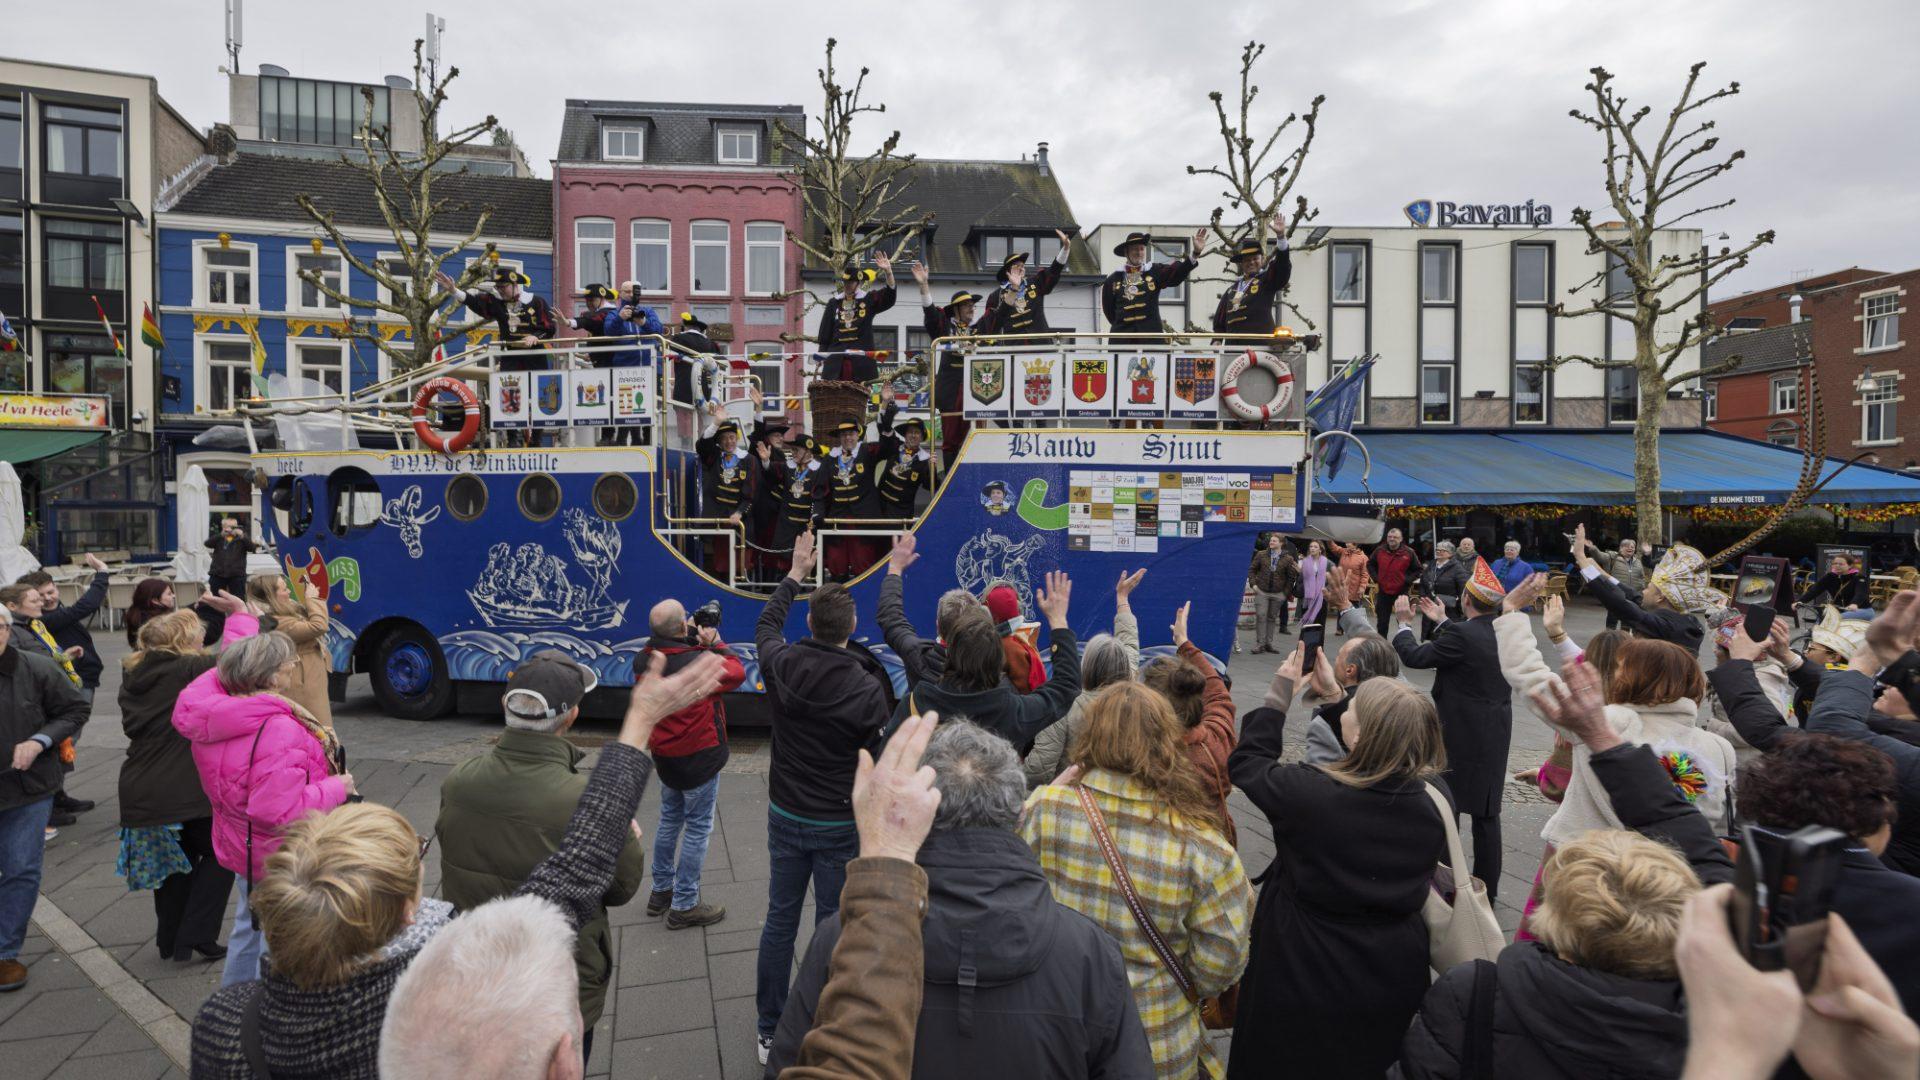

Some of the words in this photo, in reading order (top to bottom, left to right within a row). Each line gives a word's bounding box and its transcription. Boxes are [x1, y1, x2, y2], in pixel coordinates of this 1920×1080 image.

[1436, 198, 1552, 227] Bavaria
[11, 406, 26, 415] va
[1008, 431, 1096, 459] Blauw
[1142, 432, 1222, 463] Sjuut
[445, 455, 461, 471] de
[1228, 480, 1249, 488] VOC
[1710, 496, 1718, 504] DE
[1719, 496, 1744, 504] KROMME
[1744, 495, 1766, 503] TOETER
[331, 561, 354, 579] 1133
